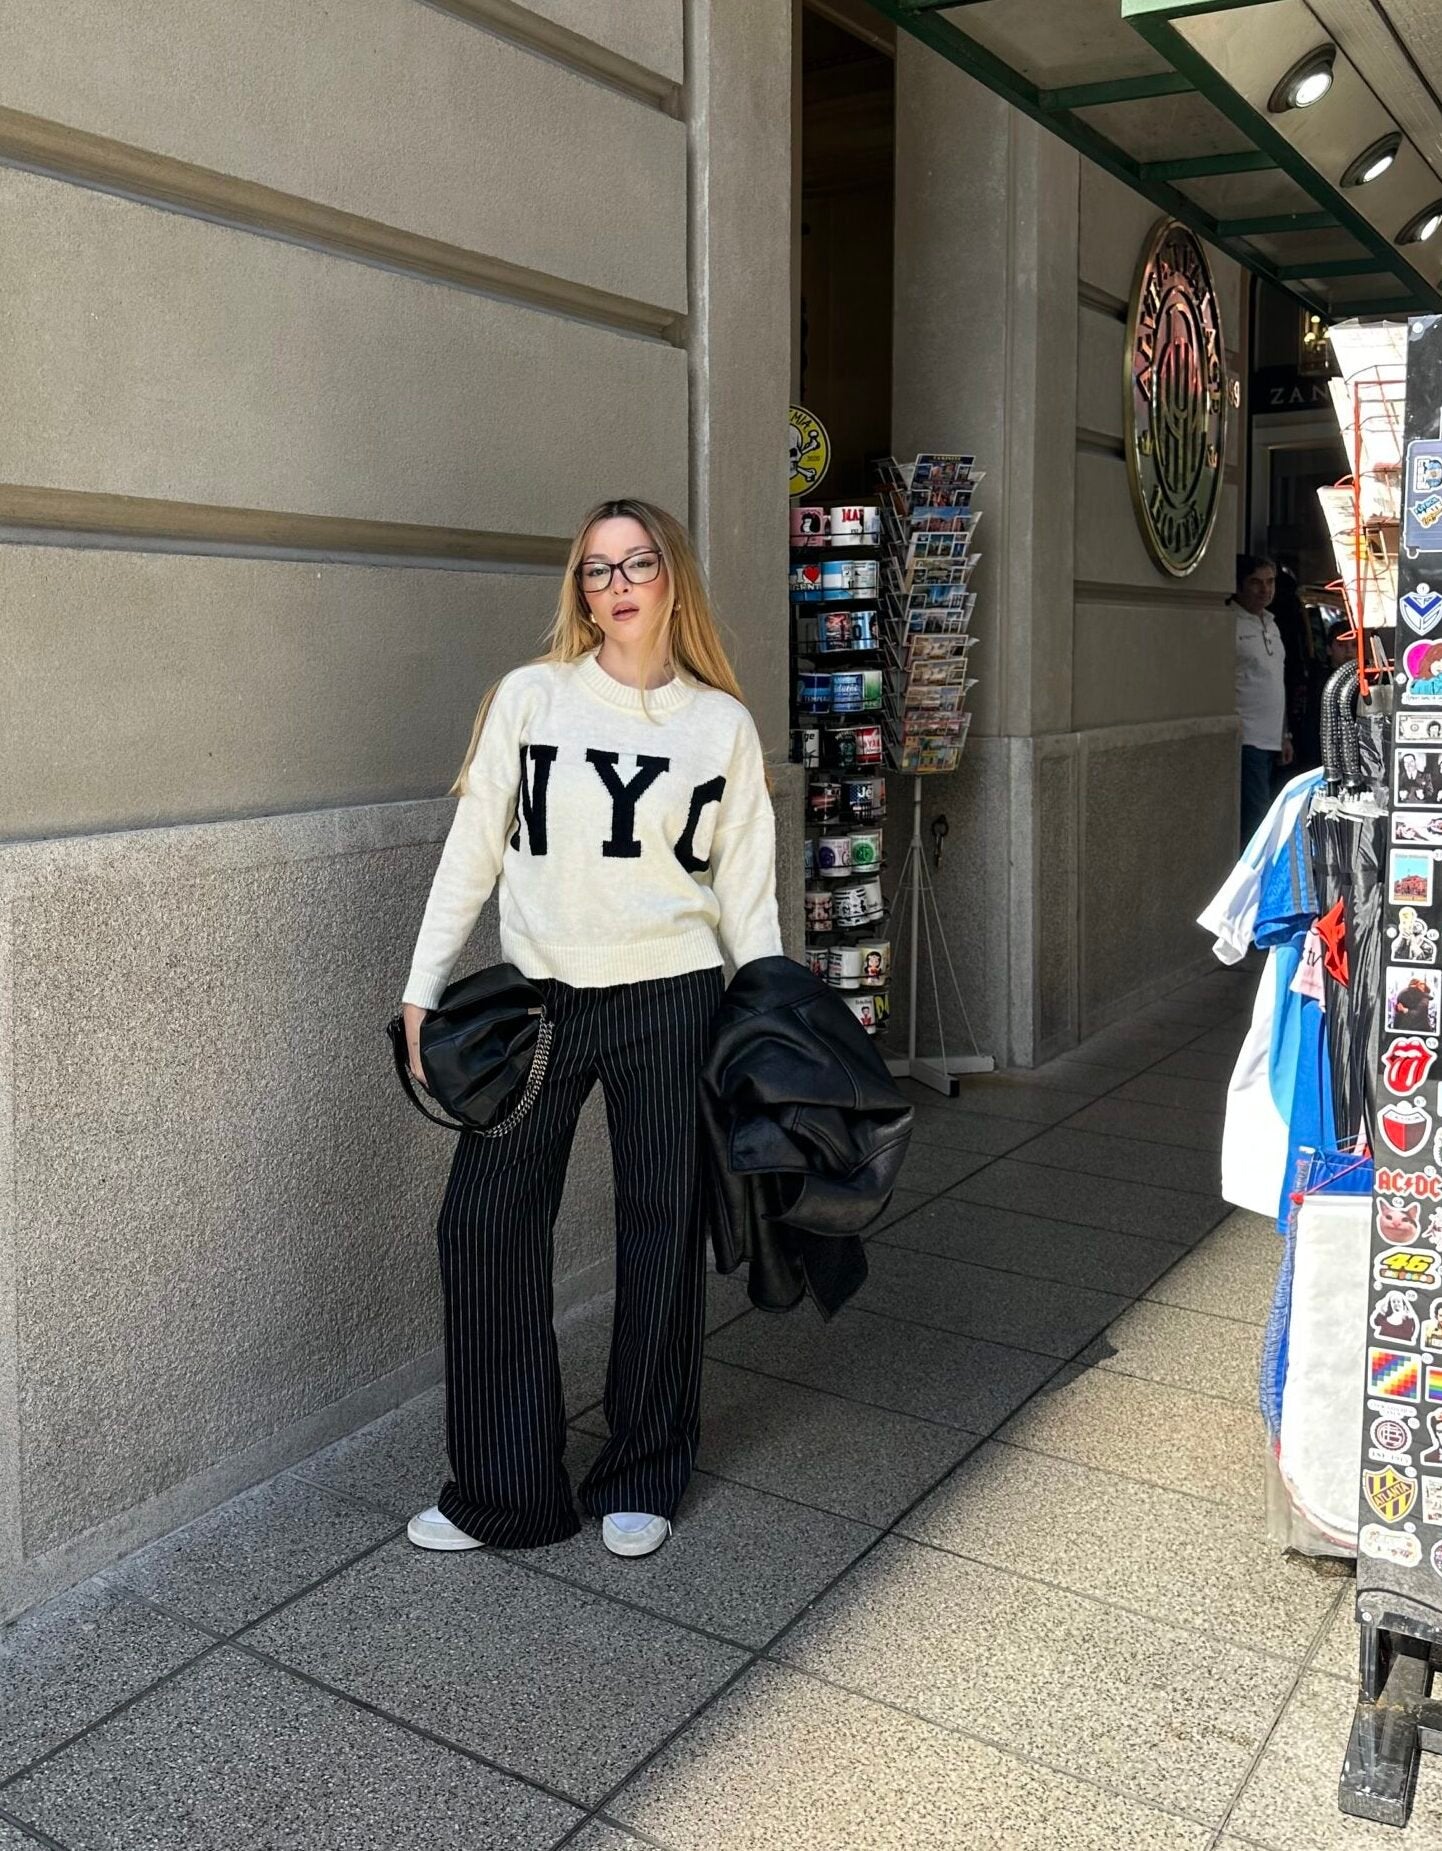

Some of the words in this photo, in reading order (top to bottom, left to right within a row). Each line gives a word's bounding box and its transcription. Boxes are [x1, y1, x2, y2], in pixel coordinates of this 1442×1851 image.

[789, 409, 812, 430] MIA
[510, 744, 727, 873] NYC
[1380, 1251, 1436, 1273] 46
[1373, 1482, 1410, 1506] ATLANTA
